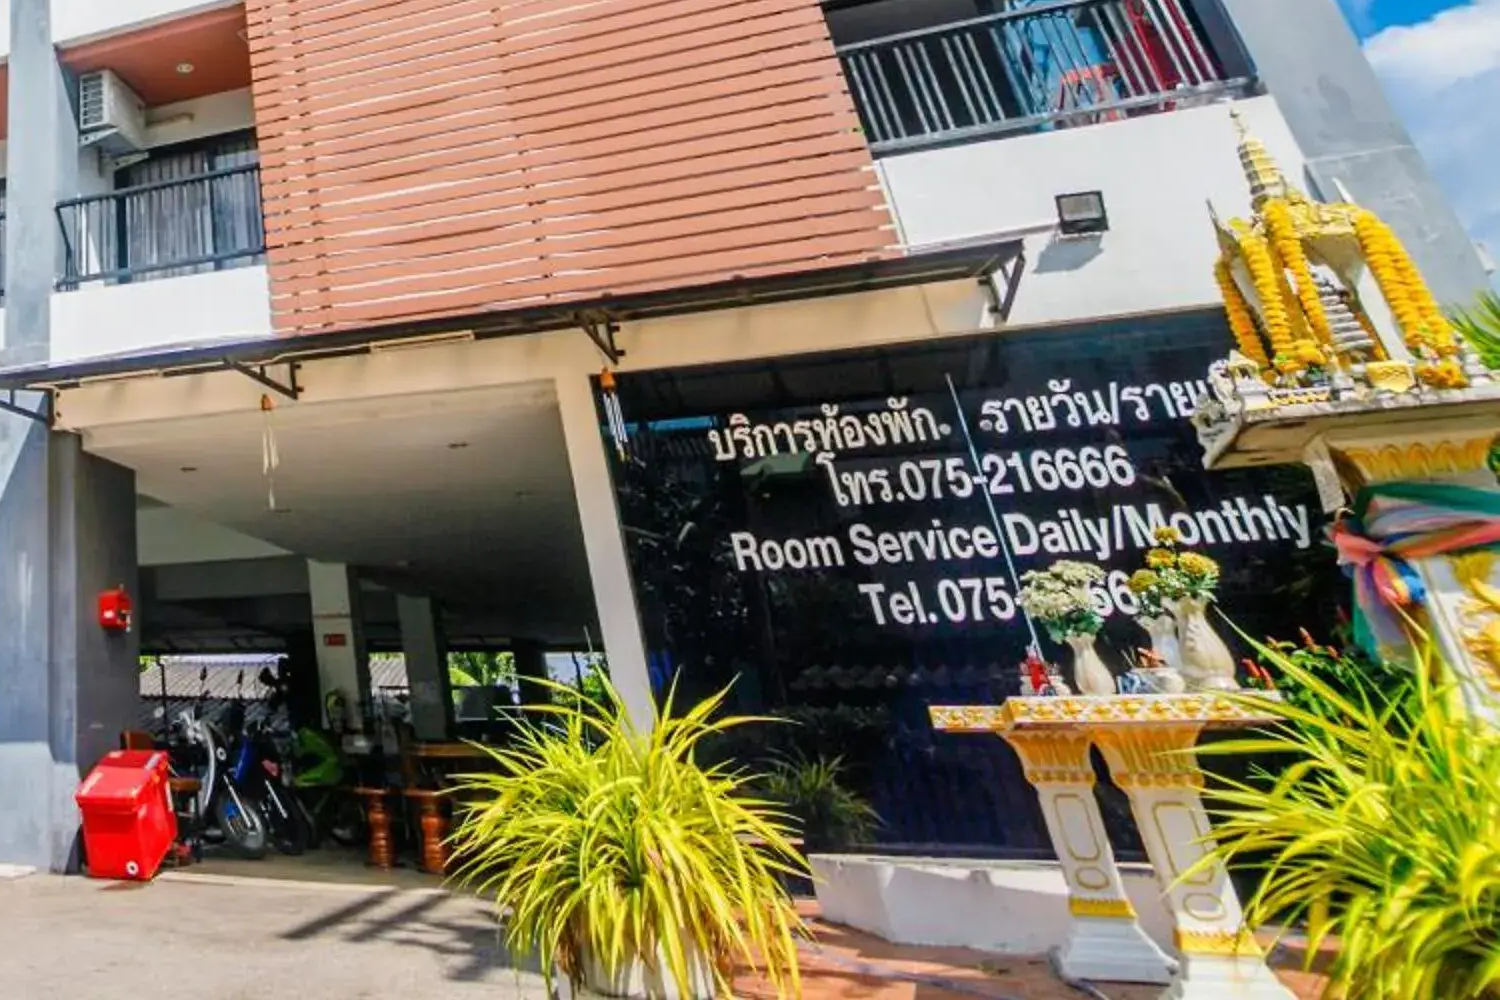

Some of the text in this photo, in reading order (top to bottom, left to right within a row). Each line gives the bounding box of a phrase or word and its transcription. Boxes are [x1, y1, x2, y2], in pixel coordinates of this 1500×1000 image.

[729, 493, 1312, 572] Room Service Daily/Monthly
